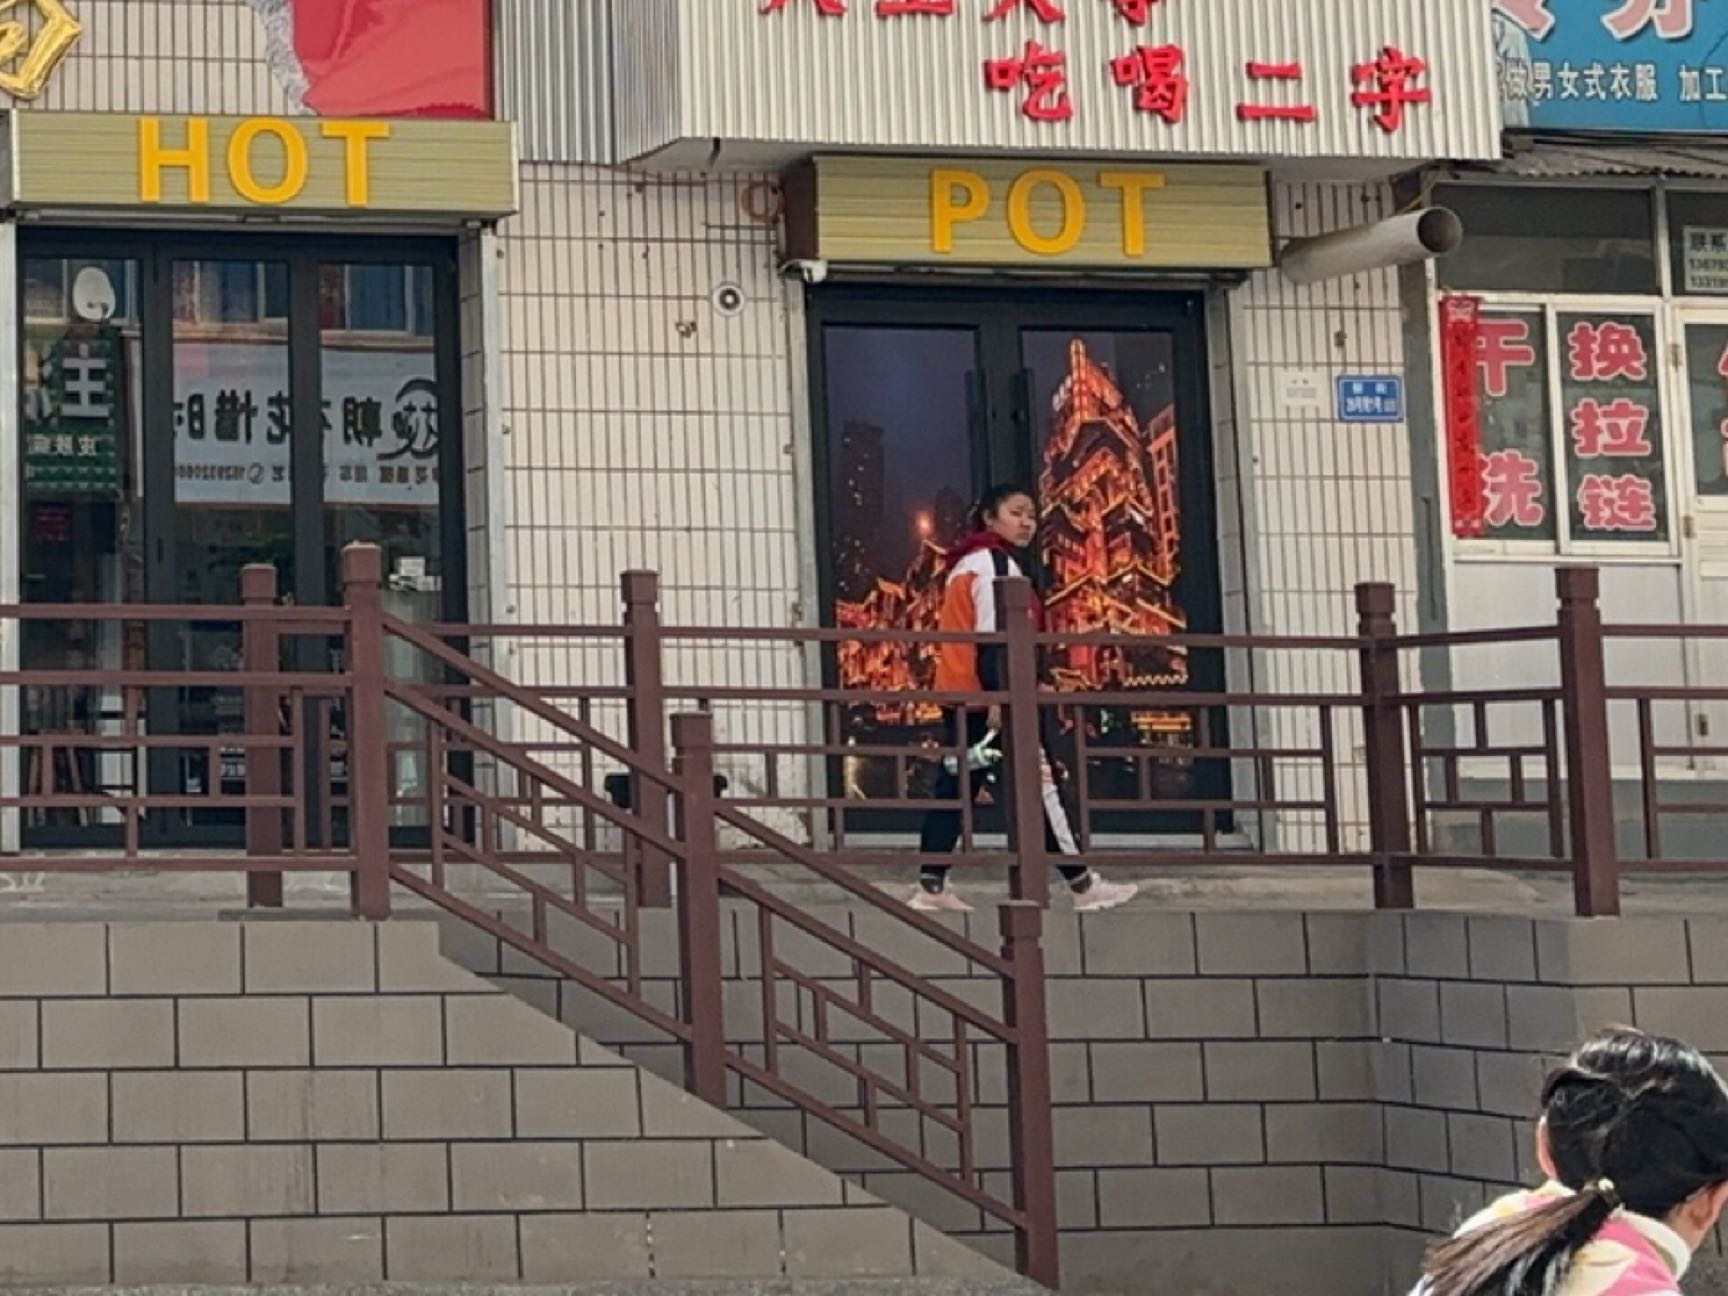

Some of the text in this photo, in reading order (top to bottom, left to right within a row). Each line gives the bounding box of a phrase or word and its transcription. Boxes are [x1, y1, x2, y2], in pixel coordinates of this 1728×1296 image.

[984, 40, 1433, 134] 吃喝二字
[139, 116, 390, 207] HOT
[928, 167, 1165, 257] POT
[1569, 321, 1656, 530] 换拉链
